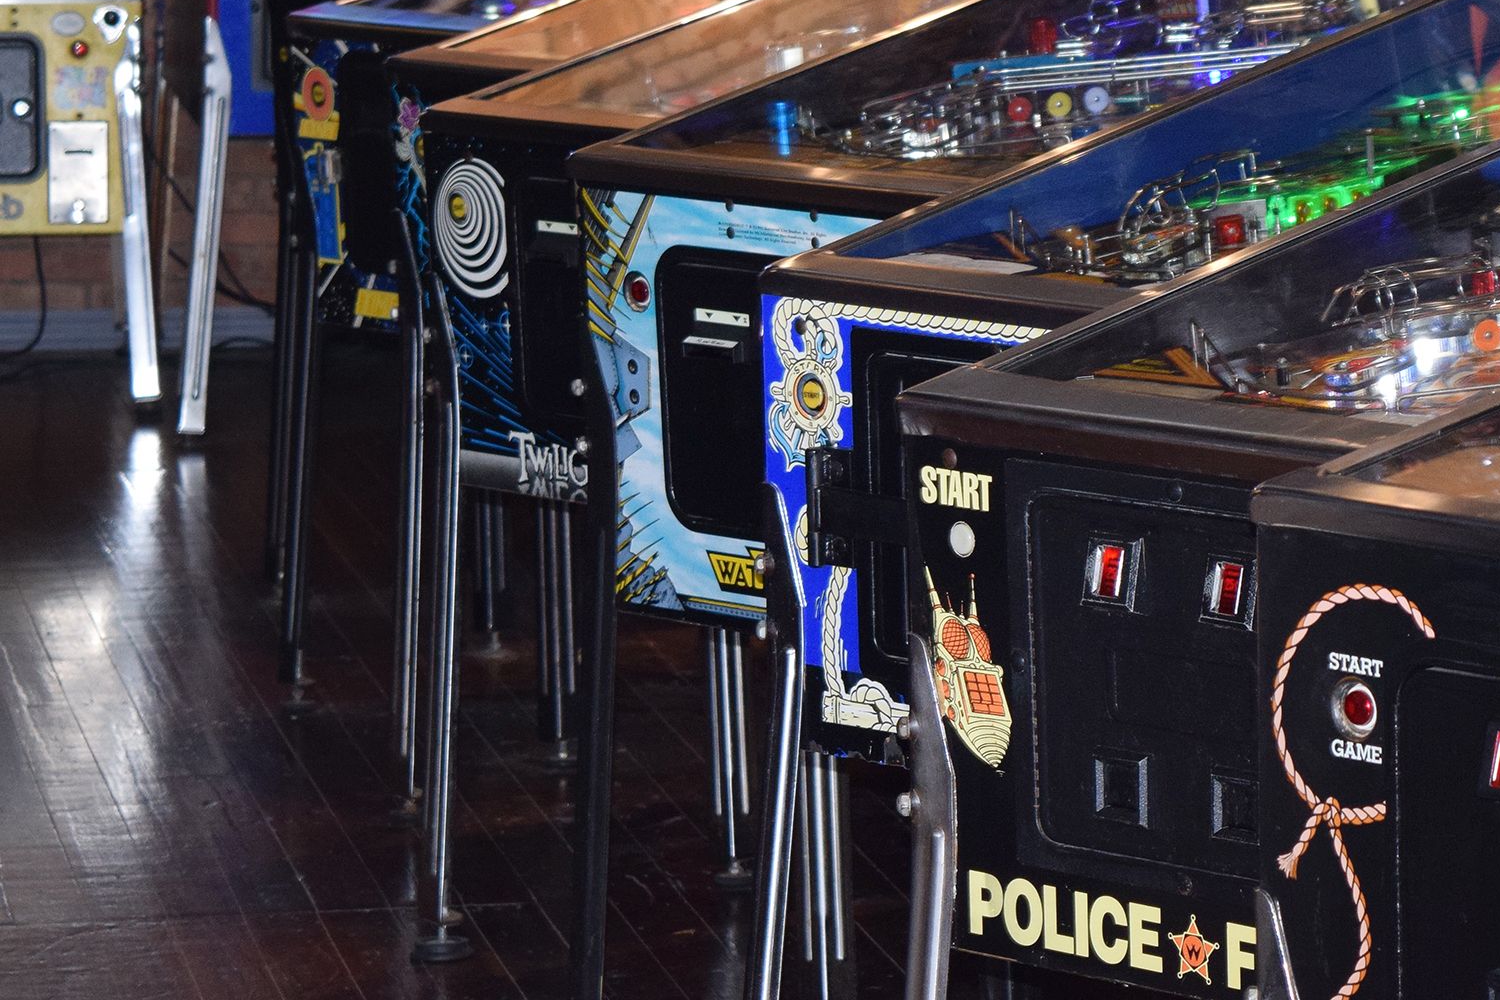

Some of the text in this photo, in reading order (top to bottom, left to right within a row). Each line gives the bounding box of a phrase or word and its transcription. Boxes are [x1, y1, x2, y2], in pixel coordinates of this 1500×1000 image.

[920, 464, 993, 513] START
[1328, 651, 1384, 679] START
[1330, 738, 1383, 765] GAME
[968, 869, 1164, 974] POLICE
